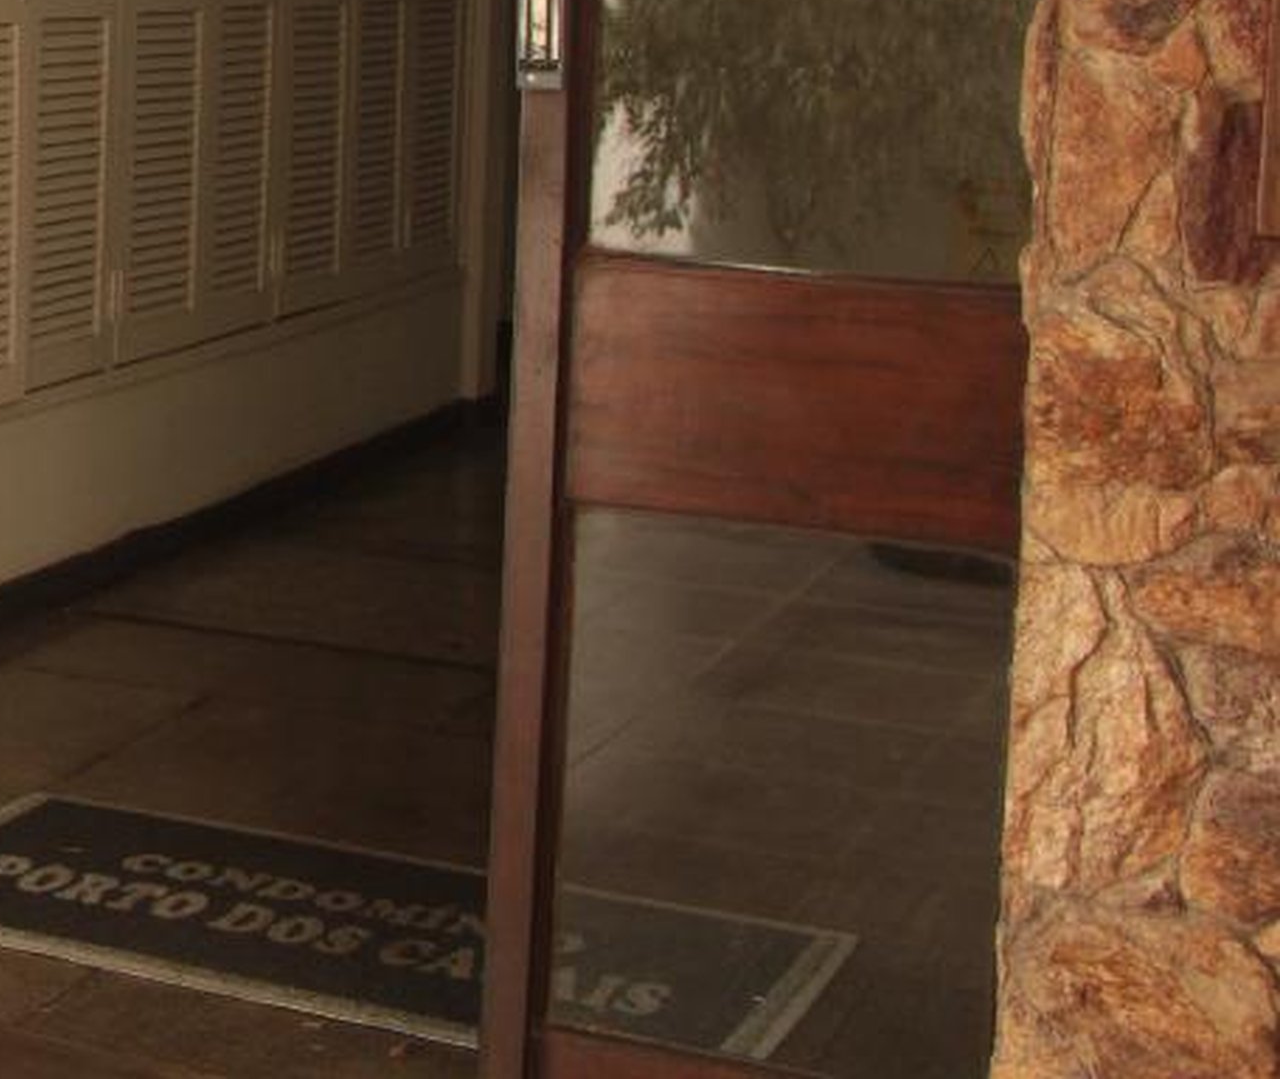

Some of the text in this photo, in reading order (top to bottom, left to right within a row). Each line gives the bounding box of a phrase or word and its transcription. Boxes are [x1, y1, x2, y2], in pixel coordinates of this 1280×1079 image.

[122, 854, 584, 952] CONDOMÍNO
[206, 902, 374, 954] DOS
[379, 938, 672, 1015] CAAIS
